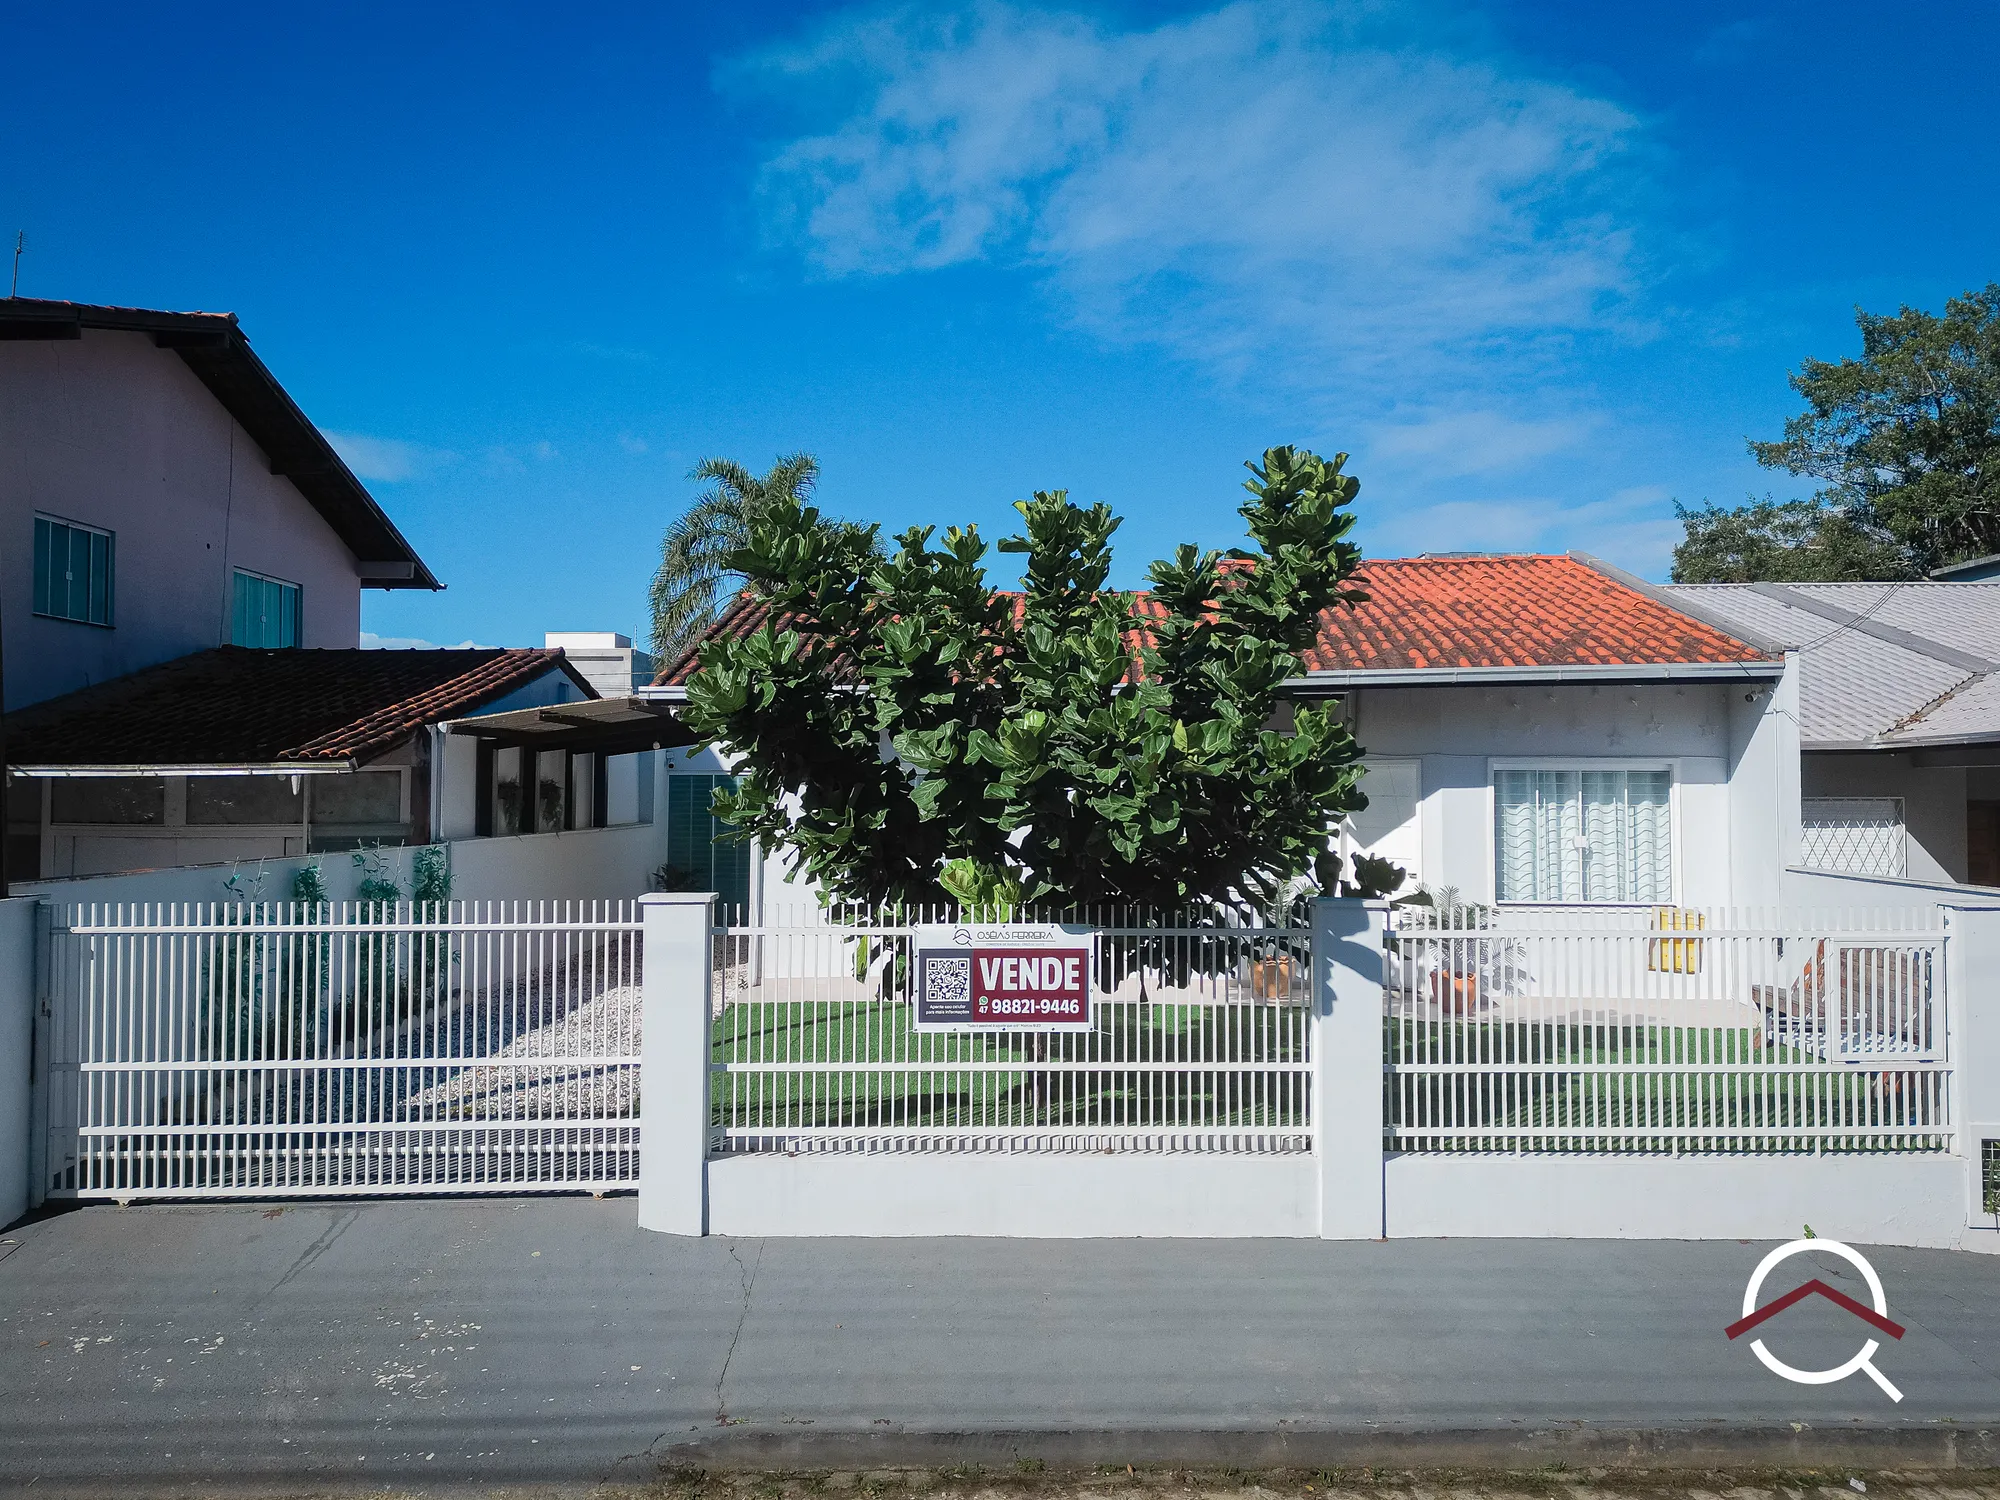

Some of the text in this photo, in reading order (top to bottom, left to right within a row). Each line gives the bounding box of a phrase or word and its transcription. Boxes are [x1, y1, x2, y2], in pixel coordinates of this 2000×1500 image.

[979, 957, 1080, 991] VENDE
[978, 999, 1080, 1014] 47 98821-9446
